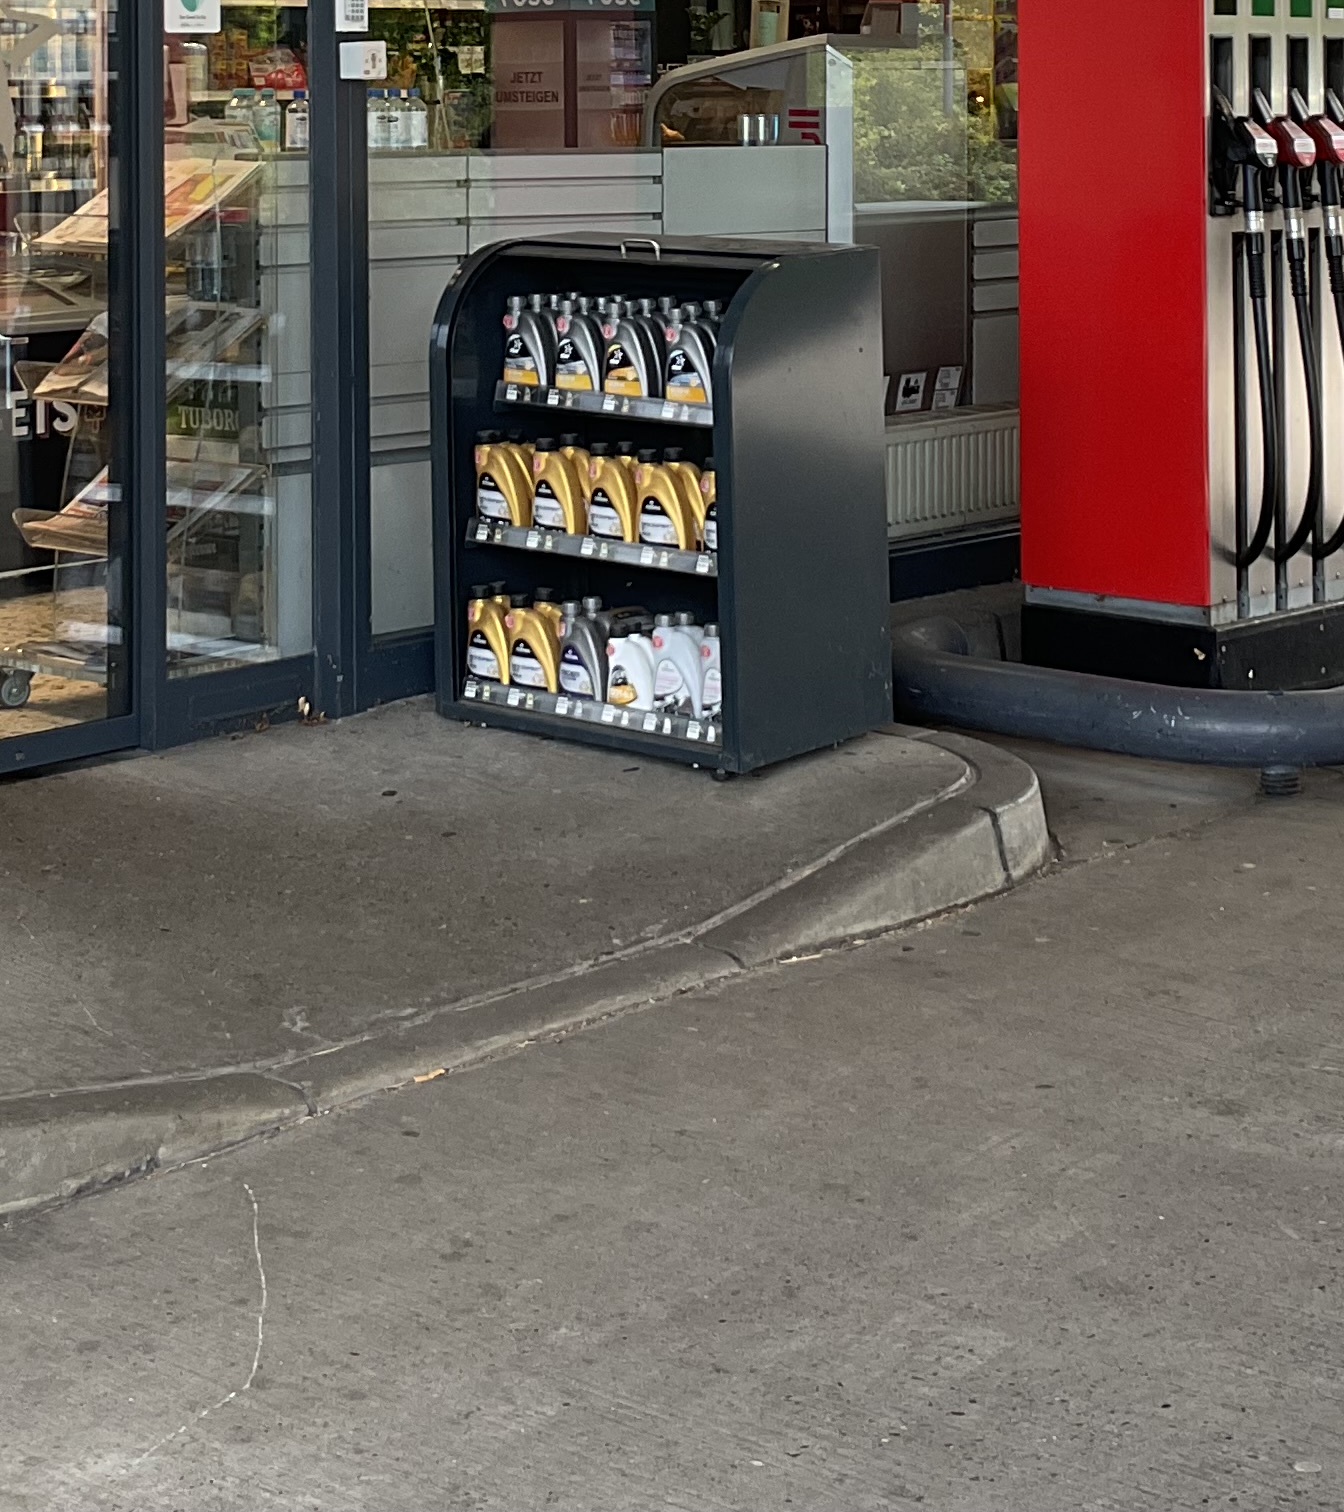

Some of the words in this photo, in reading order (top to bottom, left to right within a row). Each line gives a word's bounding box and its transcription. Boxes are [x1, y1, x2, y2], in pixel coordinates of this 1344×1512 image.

[510, 71, 544, 84] JETZT
[495, 90, 559, 103] UMSTEIGEN
[10, 389, 78, 437] EIS
